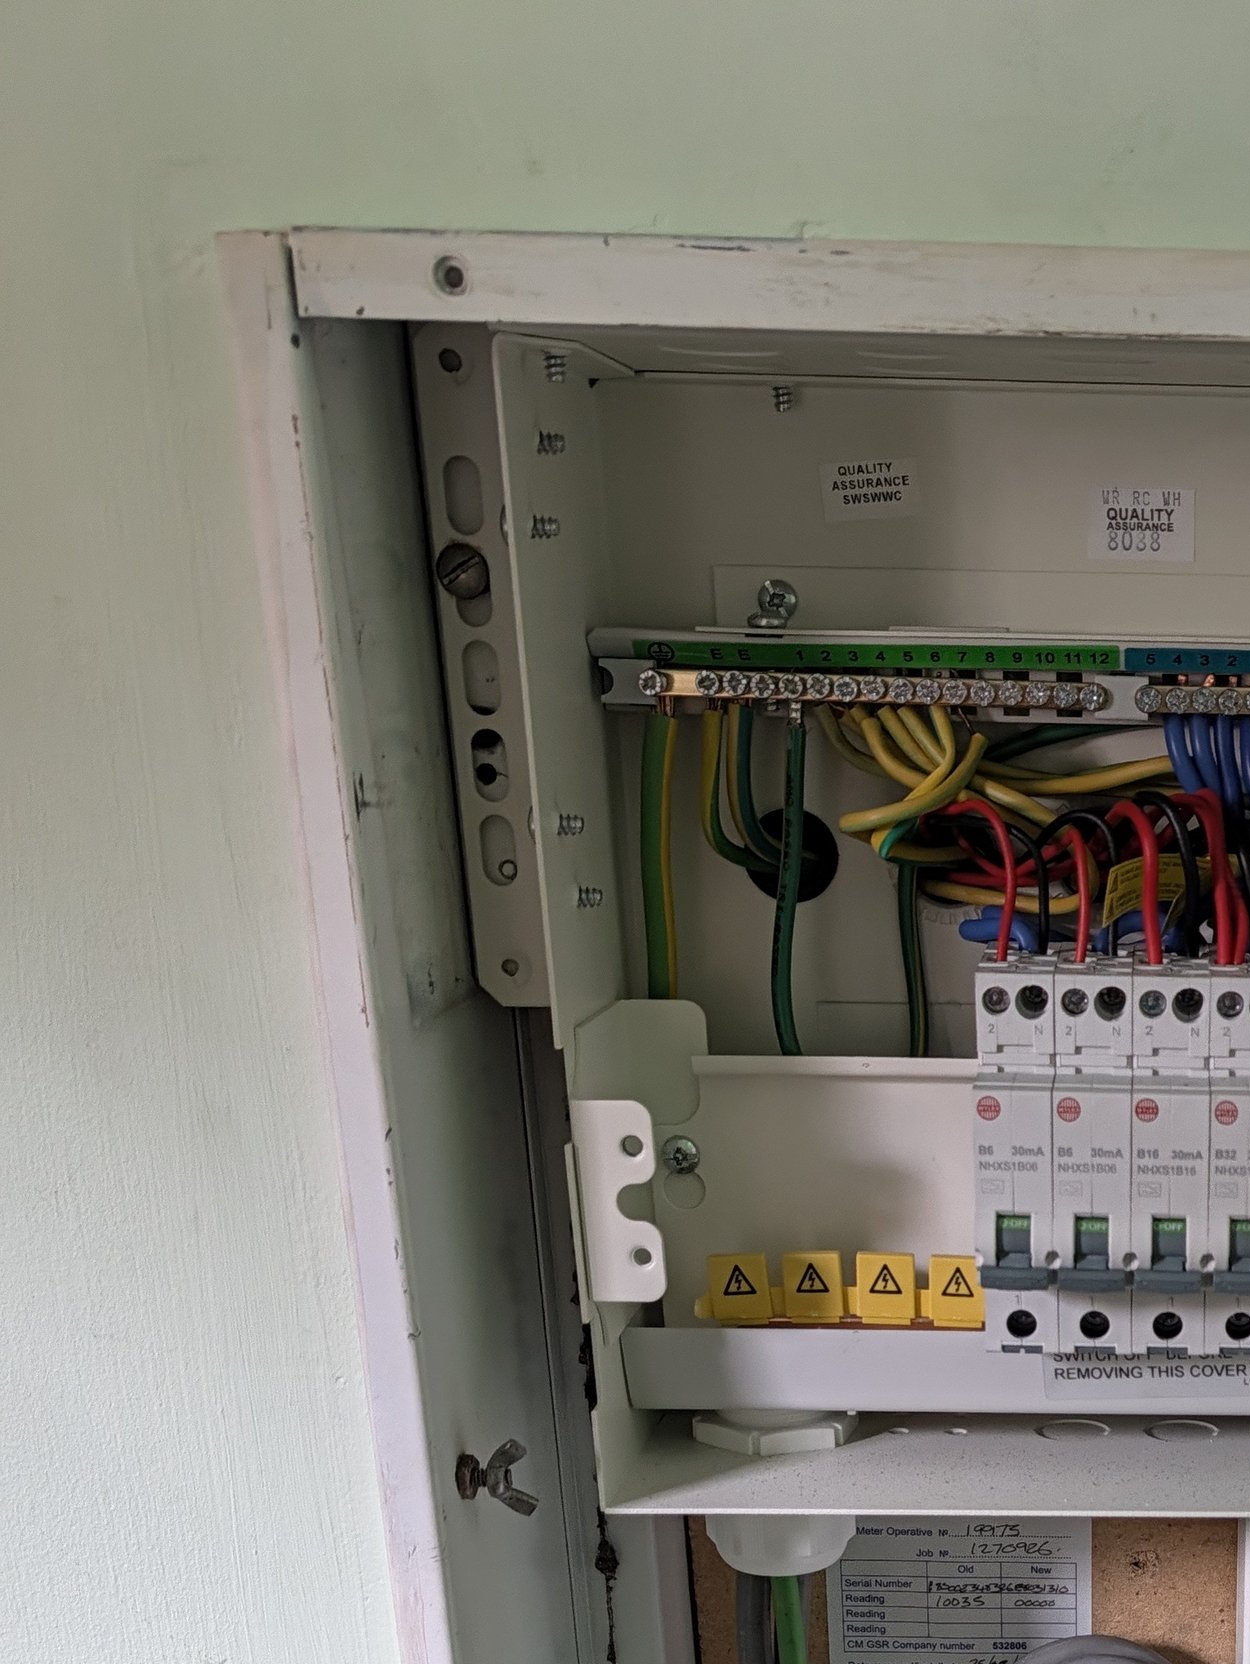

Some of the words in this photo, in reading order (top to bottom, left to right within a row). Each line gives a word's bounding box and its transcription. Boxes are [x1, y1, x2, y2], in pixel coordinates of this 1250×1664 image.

[837, 462, 893, 477] QUALITY
[831, 475, 910, 491] ASSURANCE
[843, 490, 903, 505] SWSWWC
[1106, 507, 1175, 522] QUALITY
[1106, 521, 1175, 533] ASSURANCE
[710, 648, 724, 661] E
[737, 649, 751, 662] E
[795, 649, 804, 662] 1
[820, 649, 832, 662] 2
[847, 650, 859, 662] 3
[874, 650, 887, 663] 4
[903, 650, 914, 663] 5
[929, 650, 941, 663] 6
[957, 650, 968, 663] 7
[984, 651, 996, 664] 8
[1011, 651, 1023, 664] 9
[1034, 651, 1056, 665] 10
[1064, 651, 1082, 665] 11
[1089, 652, 1110, 666] 12
[1145, 653, 1157, 666] 5
[1171, 653, 1183, 666] 4
[1199, 654, 1211, 667] 3
[1226, 654, 1238, 667] 2
[978, 1146, 994, 1156] B6
[1011, 1146, 1045, 1157] 30mA
[1058, 1147, 1073, 1158] B6
[1090, 1148, 1123, 1159] 30mA
[1137, 1149, 1159, 1160] B16
[1171, 1149, 1203, 1161] 30mA
[1215, 1149, 1237, 1160] B32
[1054, 1366, 1143, 1380] REMOVING
[1147, 1365, 1185, 1379] THIS
[1189, 1364, 1248, 1378] COVER
[856, 1527, 884, 1536] Meter
[886, 1527, 933, 1537] Operative
[916, 1549, 934, 1557] Job
[958, 1565, 974, 1573] Old
[1031, 1566, 1052, 1574] New
[845, 1579, 872, 1588] Serial
[877, 1579, 913, 1588] Number
[845, 1594, 885, 1604] Reading
[846, 1610, 886, 1620] Reading
[846, 1625, 886, 1635] Reading
[847, 1640, 864, 1649] CM
[867, 1640, 889, 1649] GSR
[893, 1640, 937, 1651] Company
[940, 1641, 975, 1650] number
[992, 1641, 1027, 1650] 532806
